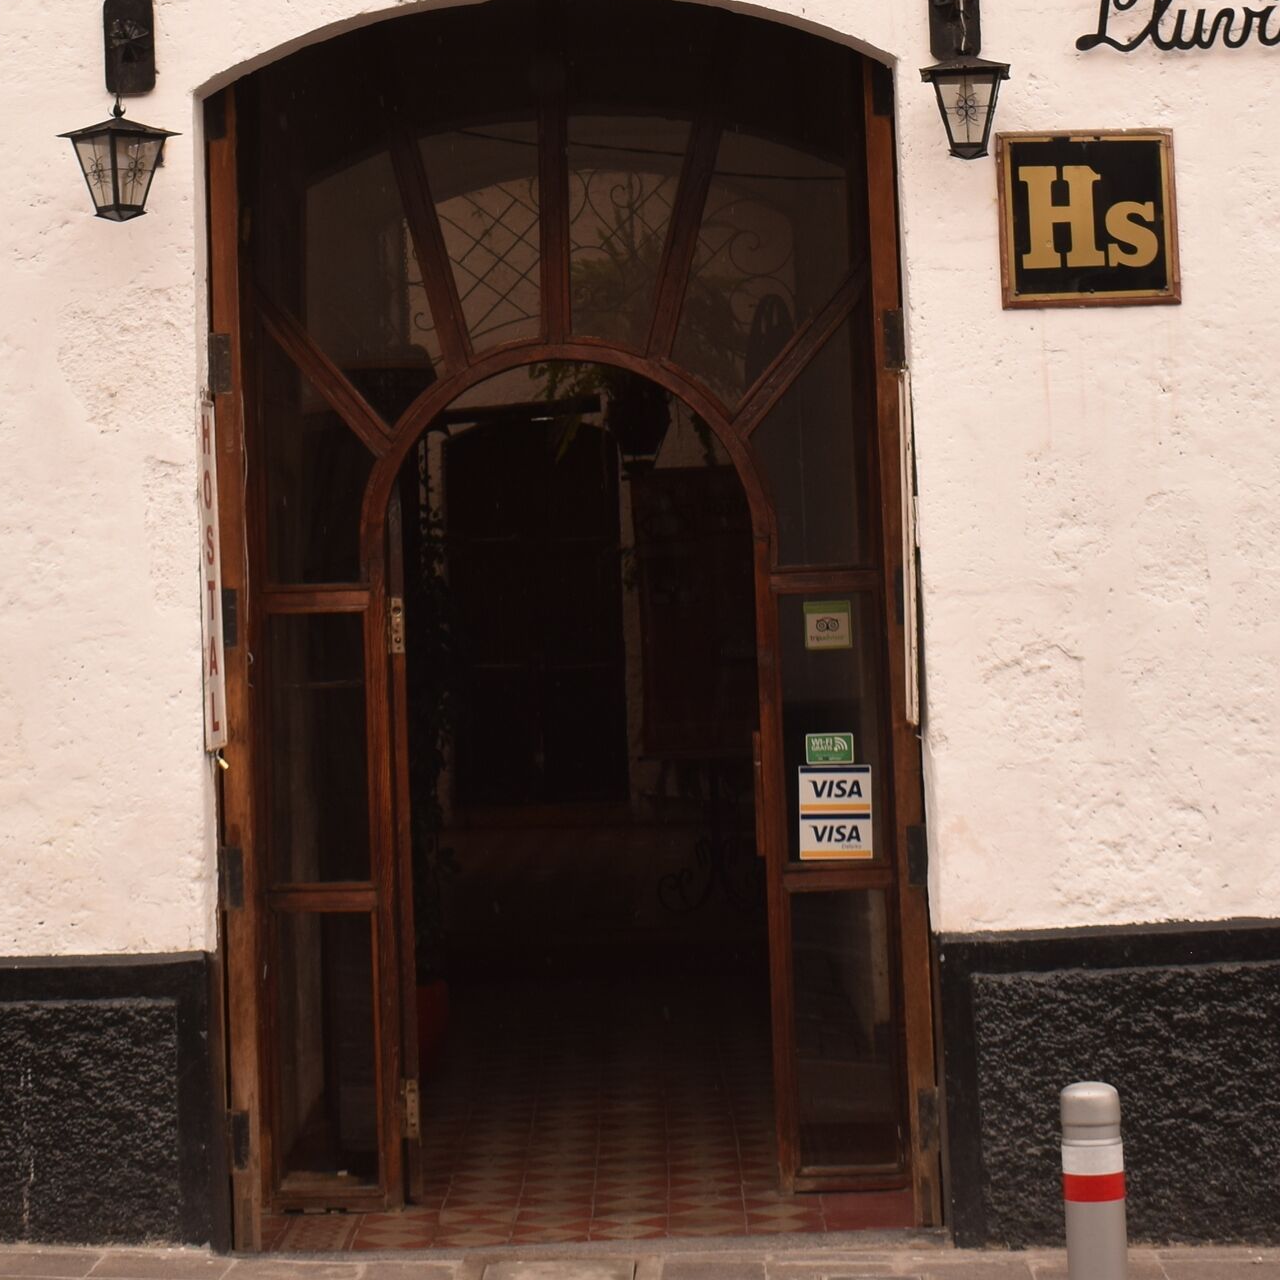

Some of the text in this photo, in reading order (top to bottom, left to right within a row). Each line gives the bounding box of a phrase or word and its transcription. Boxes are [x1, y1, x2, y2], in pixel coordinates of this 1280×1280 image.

[1018, 165, 1159, 270] Hs
[202, 414, 220, 732] HOSTAL
[808, 780, 863, 798] VISA
[809, 825, 862, 843] VISA
